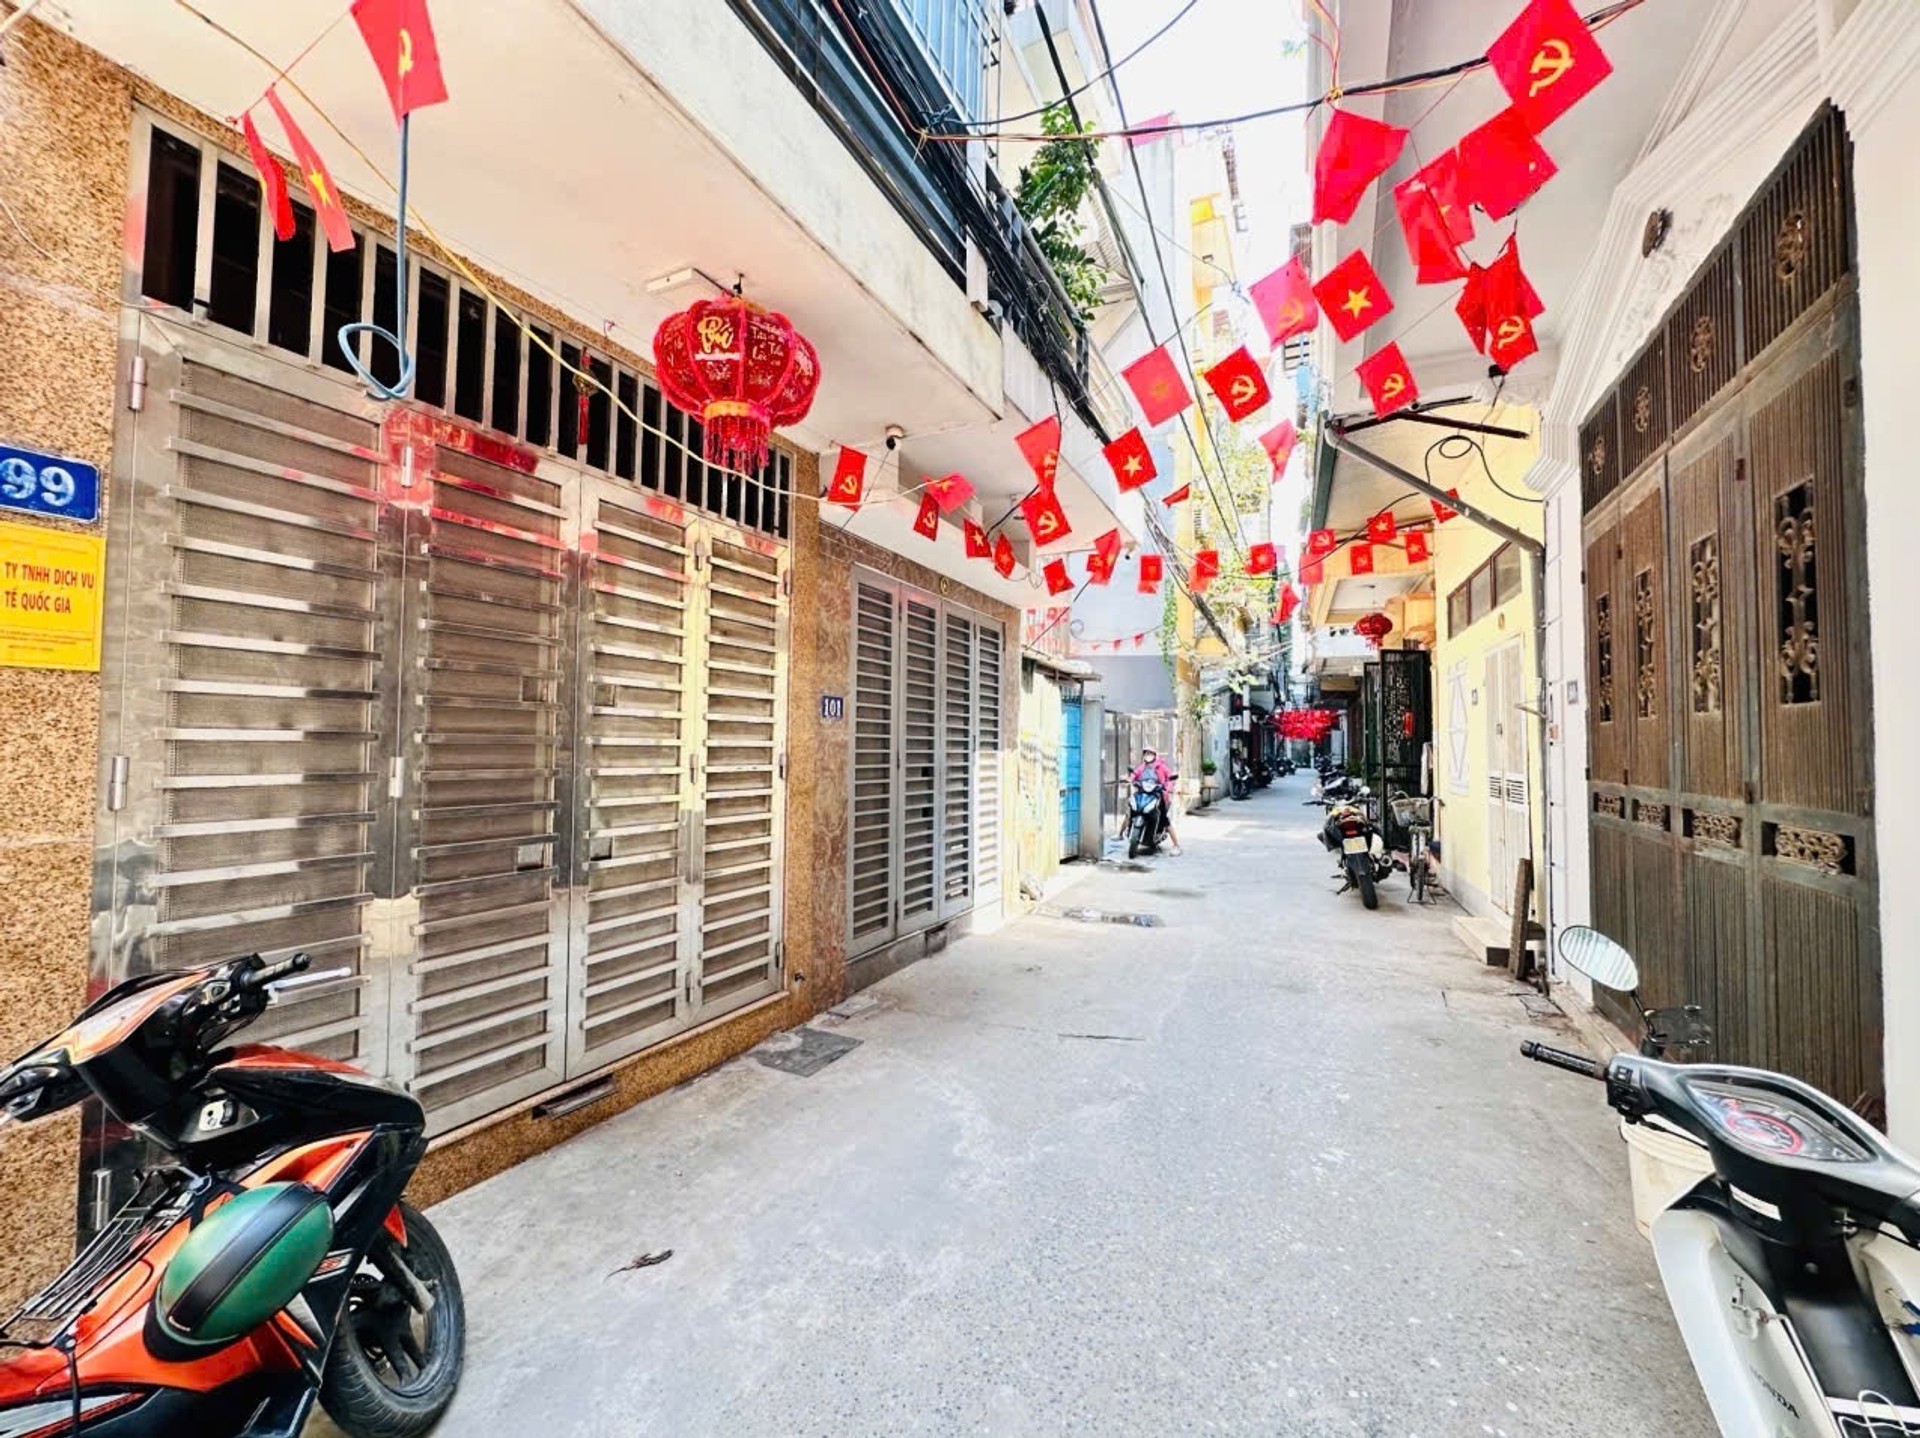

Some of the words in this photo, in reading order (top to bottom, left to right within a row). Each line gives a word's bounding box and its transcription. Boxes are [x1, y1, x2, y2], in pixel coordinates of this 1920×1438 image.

[0, 457, 75, 507] 99
[5, 561, 18, 578] TY
[21, 564, 50, 583] TNHH
[21, 590, 50, 612] QUỐC
[54, 597, 71, 614] GIA
[824, 698, 842, 717] 101
